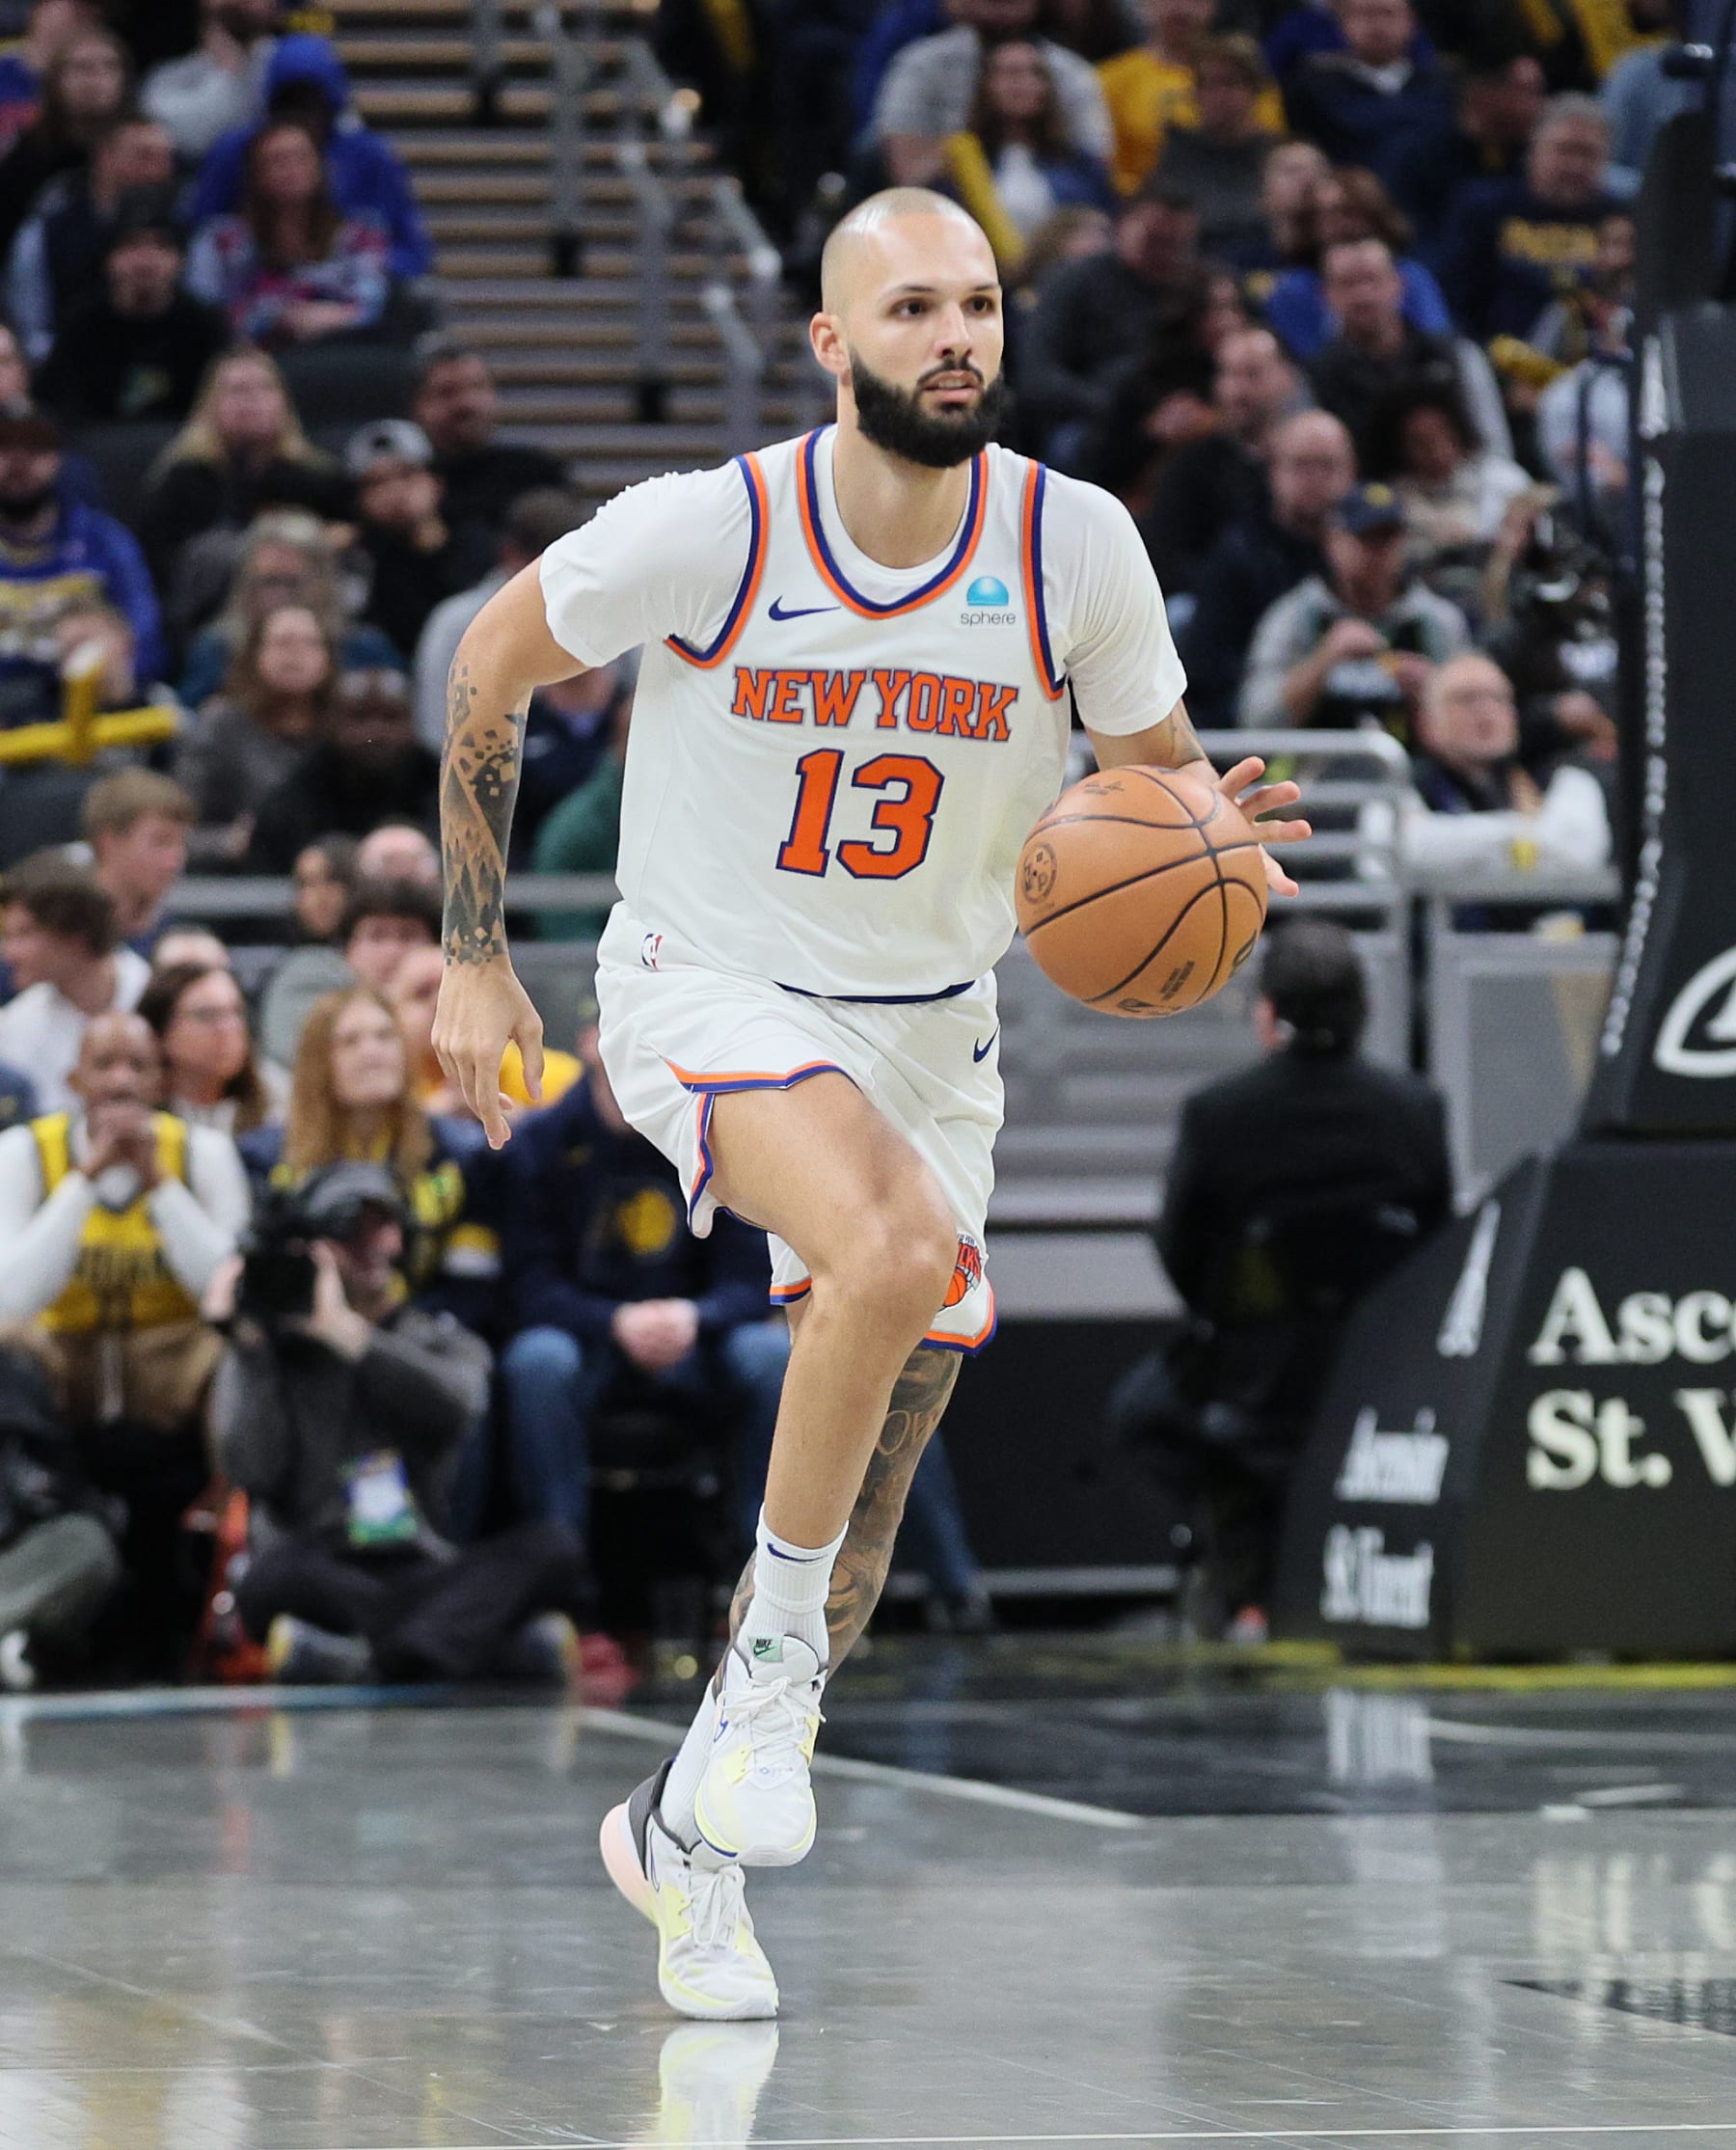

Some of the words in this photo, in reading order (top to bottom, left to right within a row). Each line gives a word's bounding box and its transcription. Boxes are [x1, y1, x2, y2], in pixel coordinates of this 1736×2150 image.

[961, 610, 1017, 627] sphere
[731, 667, 866, 727] NEW
[871, 669, 1019, 742] YORK
[775, 748, 945, 880] 13
[1529, 1266, 1736, 1366] Asc
[1526, 1389, 1673, 1491] St.
